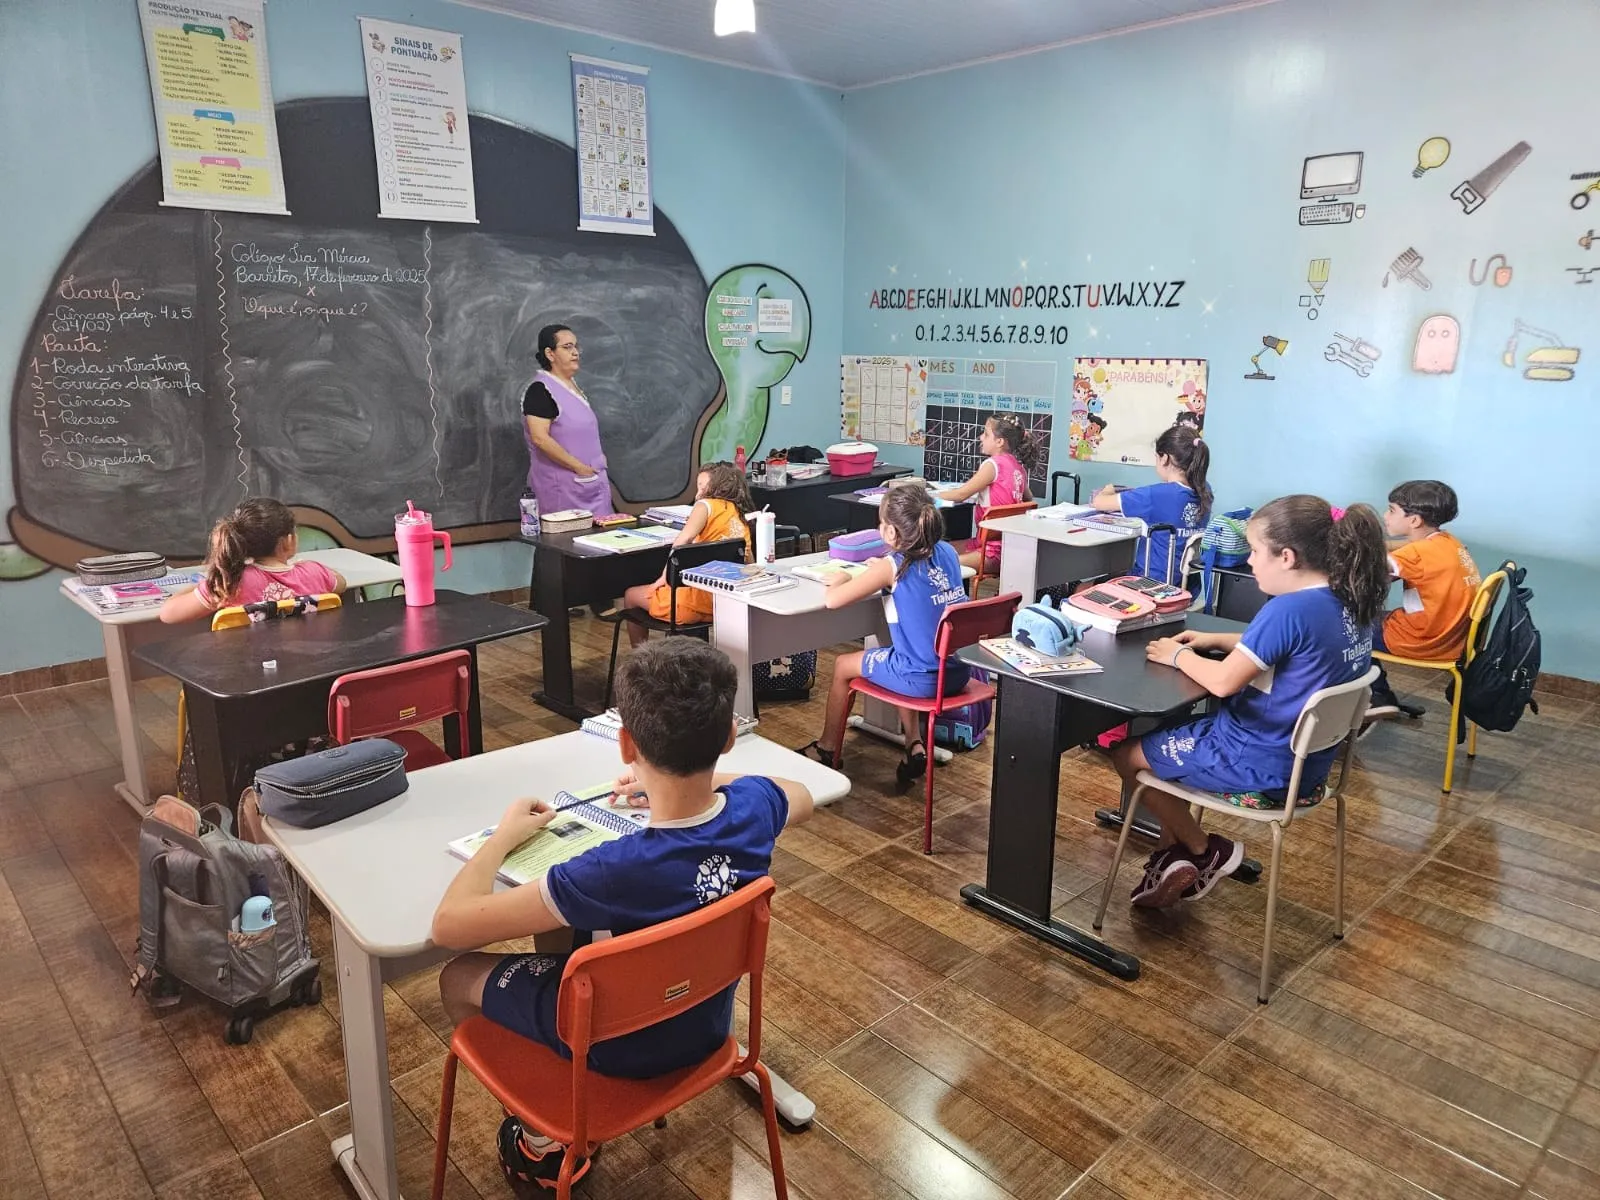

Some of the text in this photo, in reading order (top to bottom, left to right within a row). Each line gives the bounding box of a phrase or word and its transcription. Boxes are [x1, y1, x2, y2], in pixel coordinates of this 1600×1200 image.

[192, 8, 224, 20] TEXTUAL
[394, 36, 433, 51] SINAIS DE
[391, 46, 438, 62] PONTUAÇÃO
[231, 242, 370, 274] Colégio Tia Mércia
[233, 264, 426, 293] Barretos, 17 de fevereiro de 2025
[60, 274, 145, 311] Tarefa:
[160, 305, 169, 319] 4
[171, 311, 178, 319] e
[181, 306, 193, 319] 5
[41, 333, 110, 353] Pauta:
[106, 353, 191, 374] interativa
[872, 357, 892, 366] 2025
[930, 359, 955, 374] MÊS
[972, 362, 996, 375] ANO
[947, 420, 954, 435] 3
[944, 438, 956, 451] 10
[961, 456, 972, 469] 18
